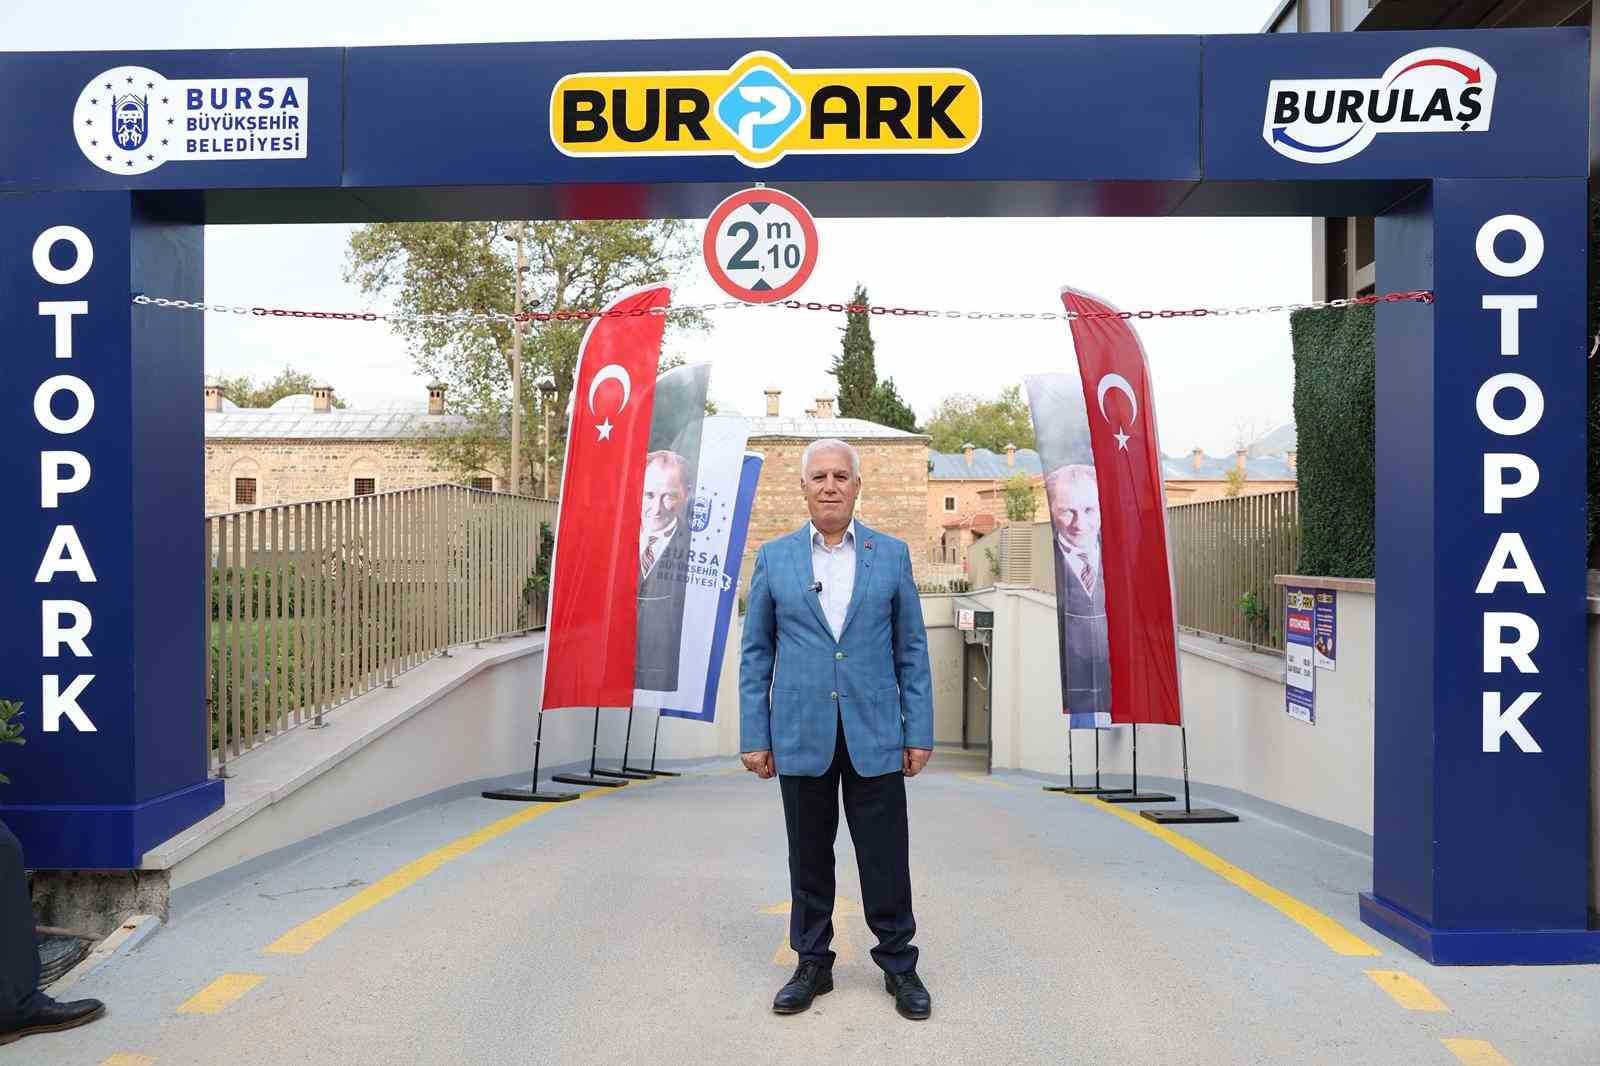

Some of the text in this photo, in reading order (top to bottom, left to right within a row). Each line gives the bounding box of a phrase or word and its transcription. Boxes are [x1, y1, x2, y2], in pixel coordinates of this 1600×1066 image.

[186, 86, 300, 111] BURSA
[1273, 86, 1483, 132] BURULAŞ
[186, 111, 300, 134] BÜYÜKŞEHİR
[186, 131, 300, 153] BELEDİYESİ
[31, 225, 98, 732] OTOPARK
[1474, 214, 1546, 754] OTOPARK
